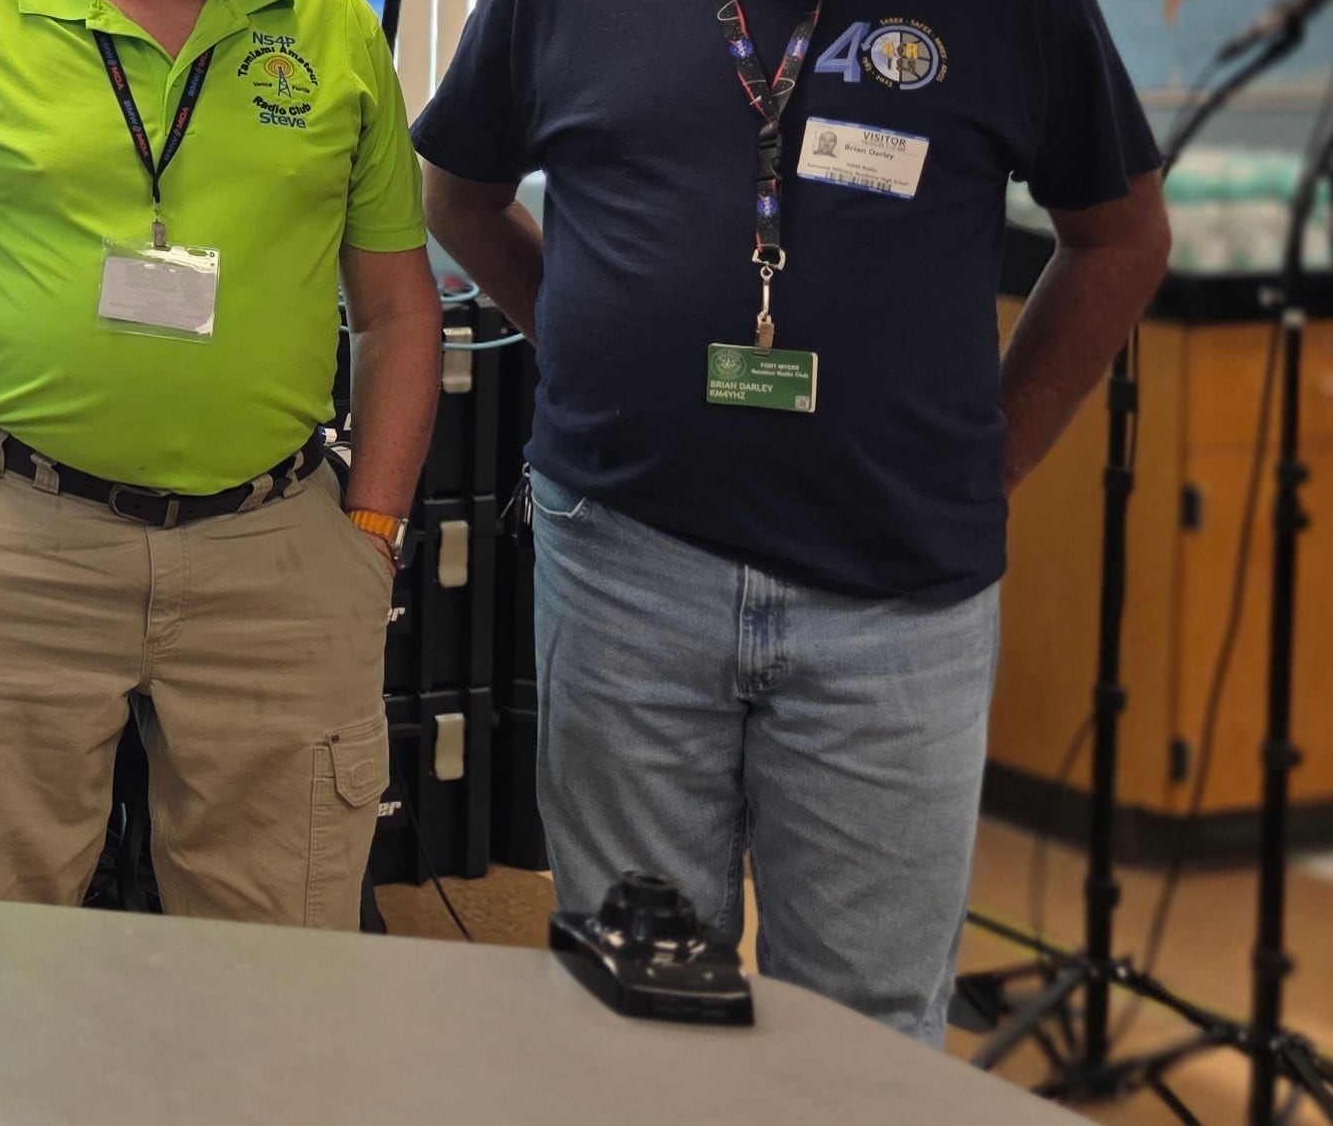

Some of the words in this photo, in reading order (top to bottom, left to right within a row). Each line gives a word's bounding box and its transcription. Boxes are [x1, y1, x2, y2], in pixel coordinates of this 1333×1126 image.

[252, 31, 296, 47] NS4P
[237, 47, 276, 77] Tamiami
[279, 46, 319, 86] Amateur
[253, 95, 287, 115] Radio
[288, 103, 311, 116] Club
[259, 112, 307, 129] Steve
[863, 131, 906, 148] VISITOR
[844, 144, 867, 154] Brian
[868, 147, 895, 161] Darley
[710, 380, 737, 390] BRIAN
[739, 382, 774, 393] DARLEY
